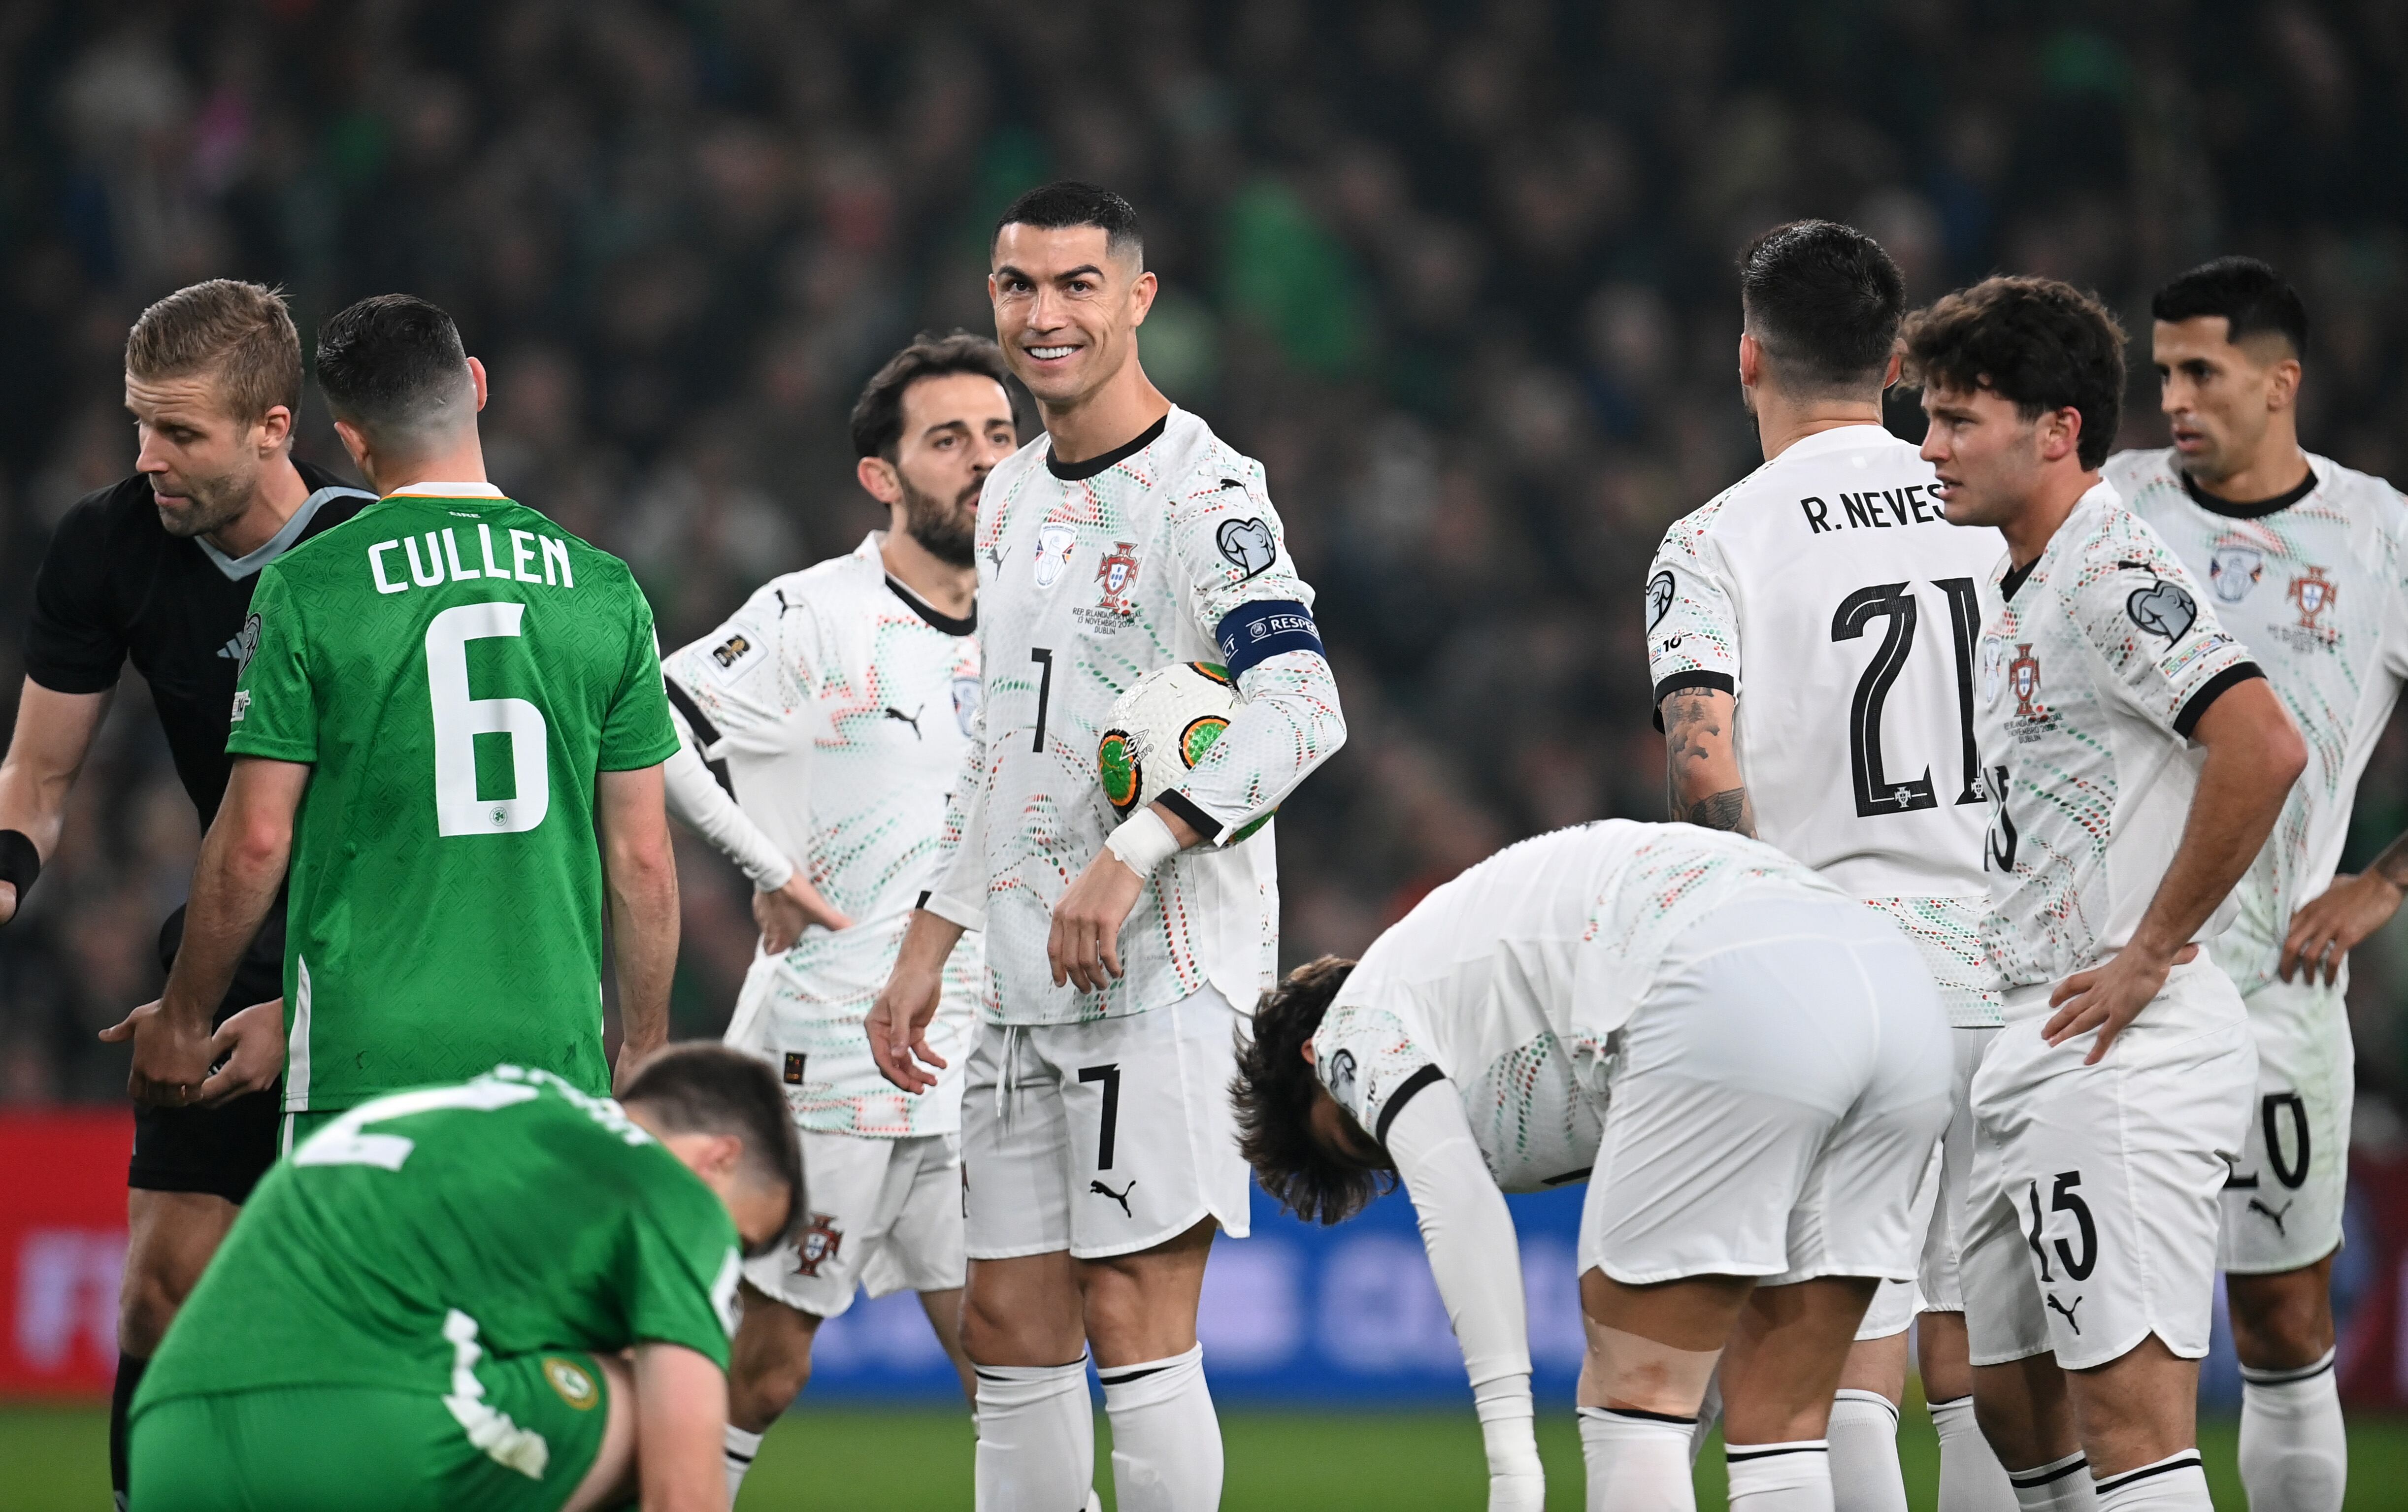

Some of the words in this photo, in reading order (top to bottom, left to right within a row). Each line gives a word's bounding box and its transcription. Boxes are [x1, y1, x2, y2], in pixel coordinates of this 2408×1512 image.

[367, 523, 573, 594] CULLEN
[1072, 607, 1084, 616] REP.
[1085, 618, 1117, 628] NOVEMBRO
[1094, 626, 1116, 635] DUBLIN
[1271, 618, 1320, 639] RESPEC
[425, 602, 549, 837] 6
[1032, 647, 1052, 753] 7
[1831, 577, 1987, 818] 21
[1128, 743, 1154, 771] umbro
[1078, 1063, 1121, 1171] 7
[2029, 1170, 2098, 1282] 15
